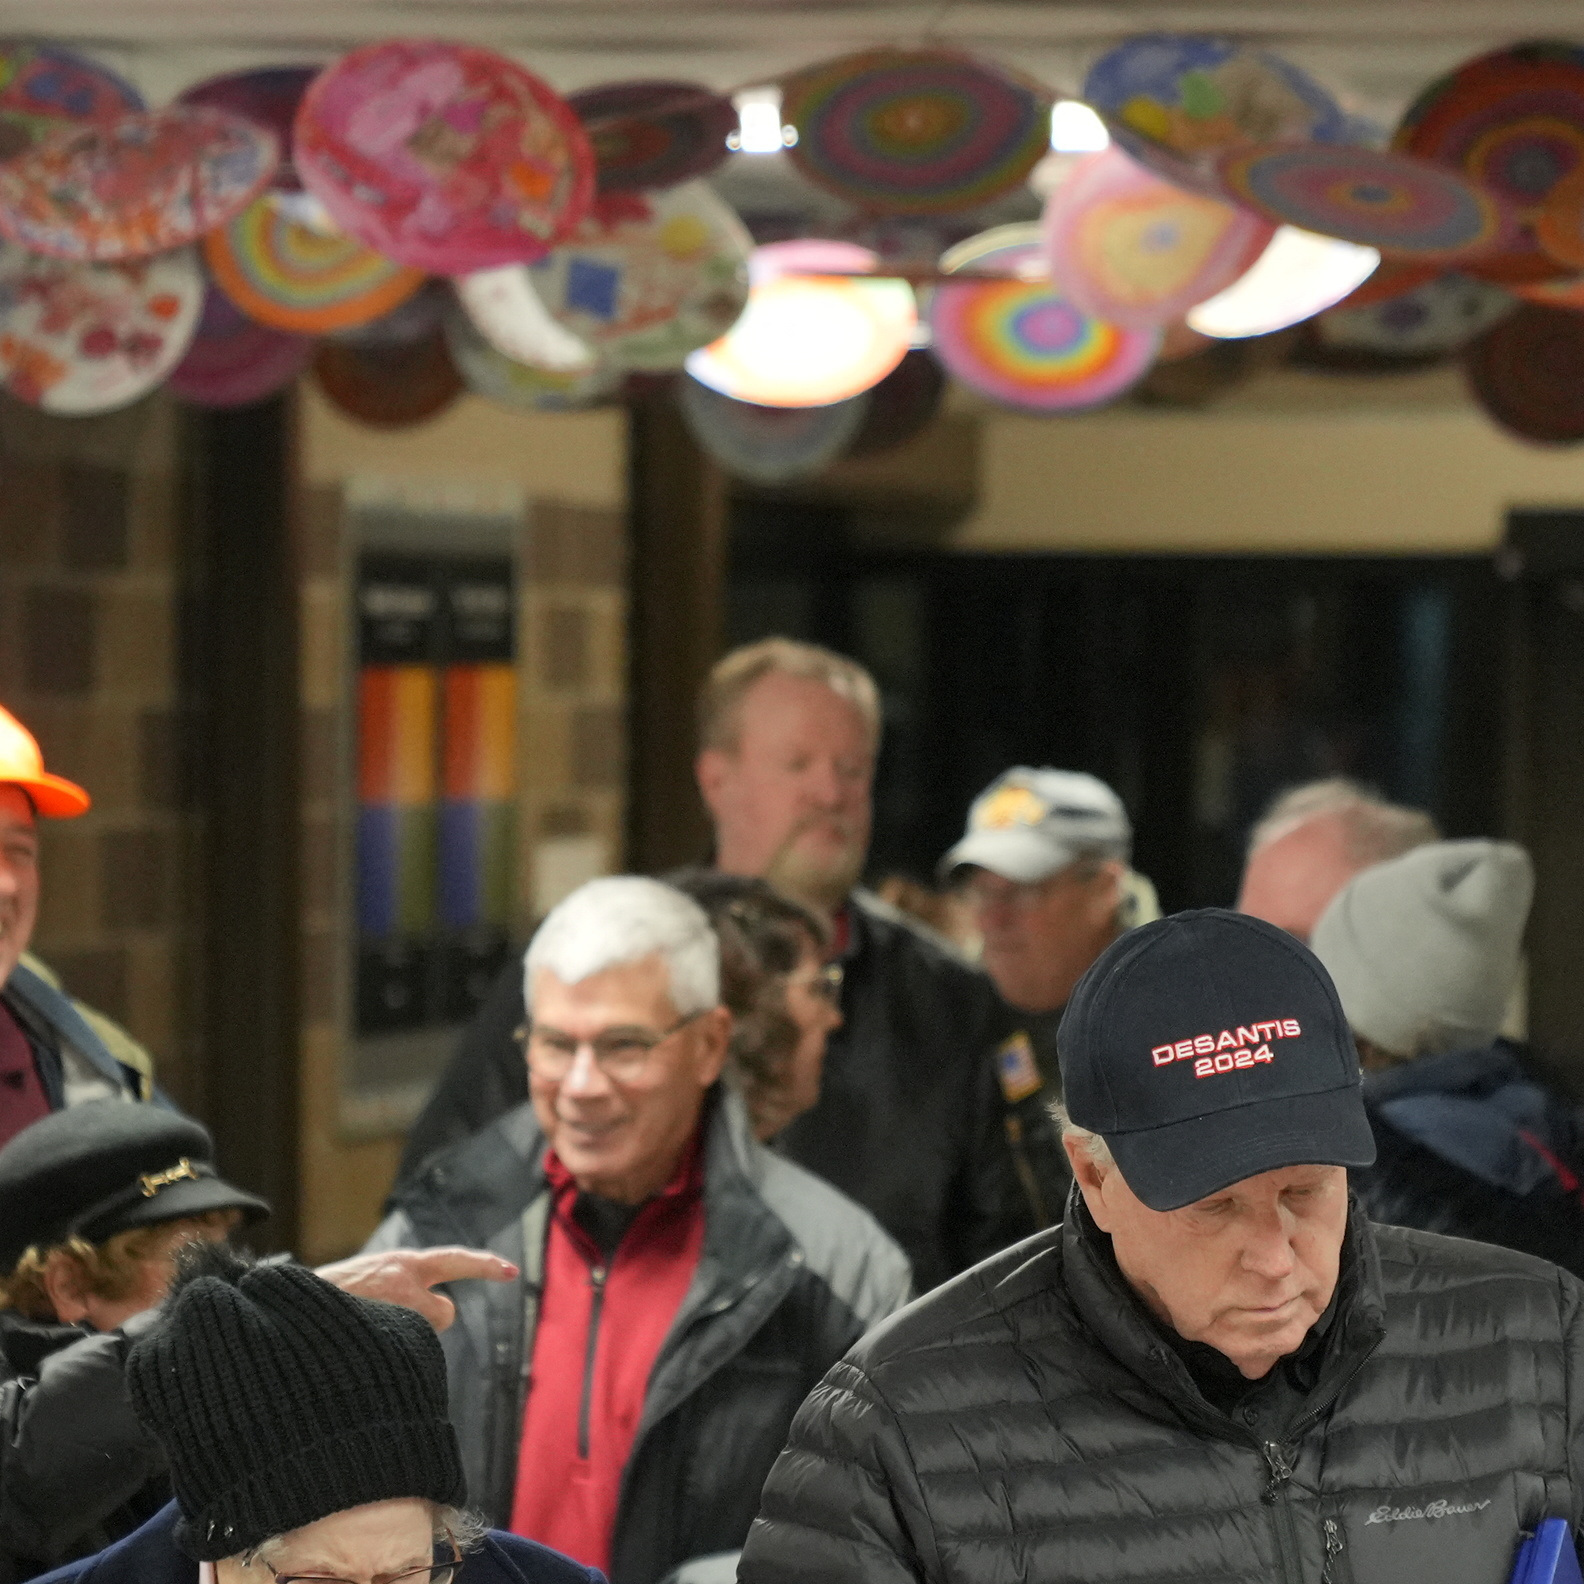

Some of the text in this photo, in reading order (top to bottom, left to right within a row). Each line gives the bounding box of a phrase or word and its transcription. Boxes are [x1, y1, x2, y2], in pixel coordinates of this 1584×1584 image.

[1151, 1018, 1302, 1068] DESANTIS
[1194, 1044, 1274, 1079] 2024
[1364, 1499, 1491, 1526] Eddie Bauer
